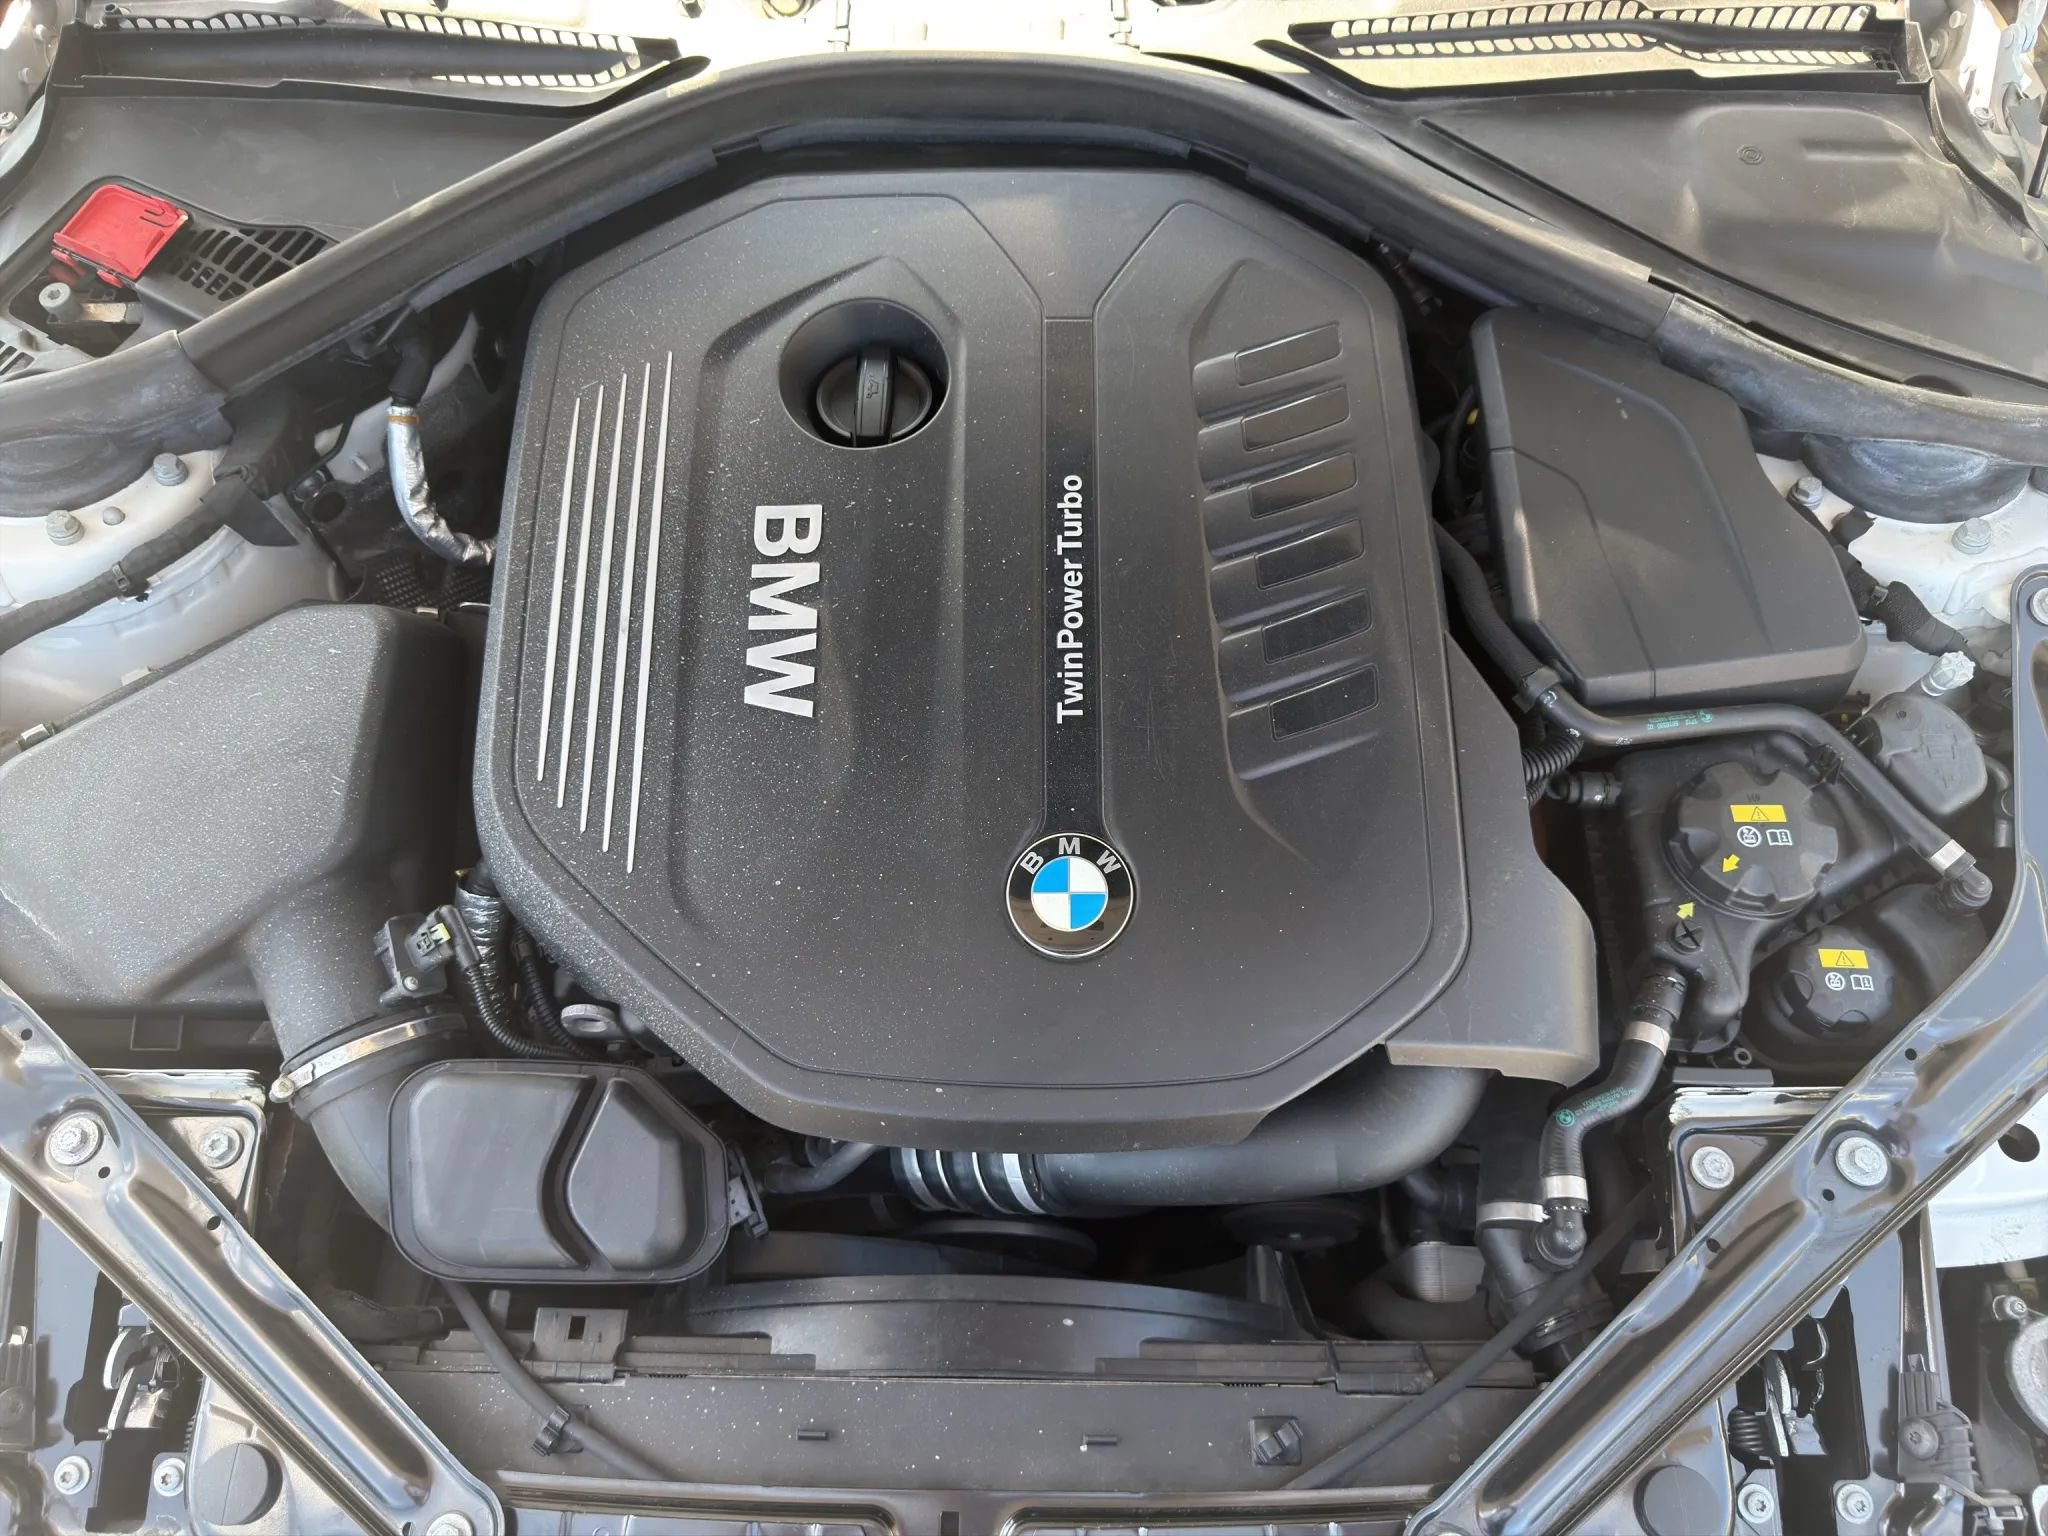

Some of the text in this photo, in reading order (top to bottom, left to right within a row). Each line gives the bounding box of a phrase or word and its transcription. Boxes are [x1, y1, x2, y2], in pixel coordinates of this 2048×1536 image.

[1057, 474, 1084, 555] Turbo
[744, 504, 822, 718] BMW
[1020, 837, 1121, 875] BMW
